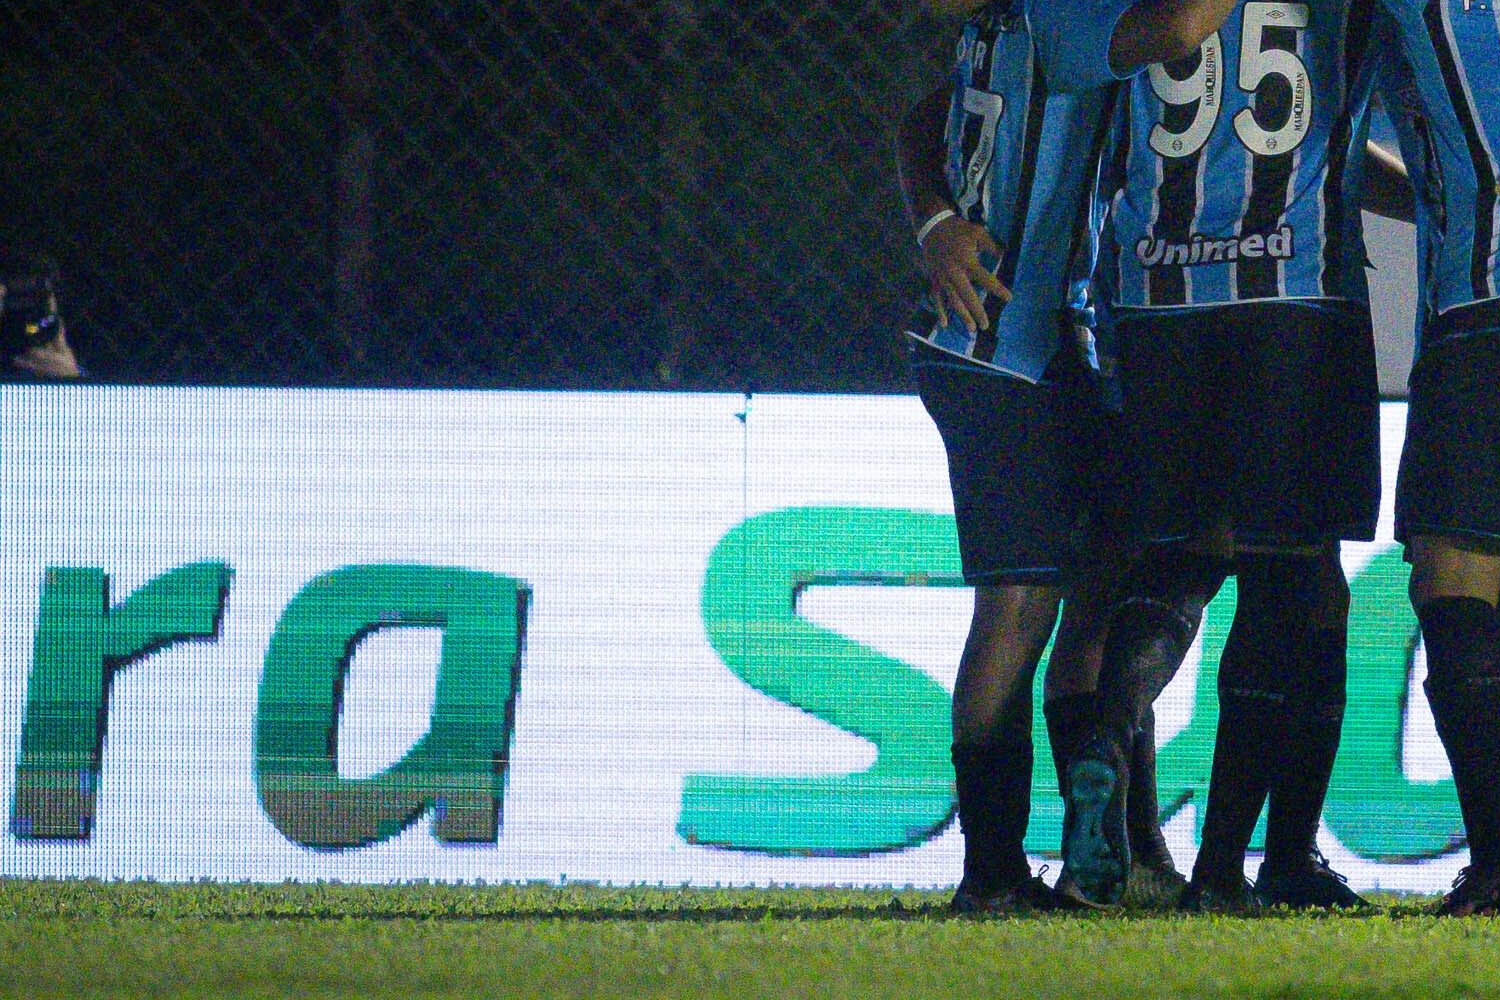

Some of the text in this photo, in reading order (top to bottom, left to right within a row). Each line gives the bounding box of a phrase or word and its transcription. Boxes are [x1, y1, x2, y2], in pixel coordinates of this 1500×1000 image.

[1148, 1, 1311, 157] 95
[1136, 226, 1292, 267] Unimed
[14, 560, 532, 850] ra
